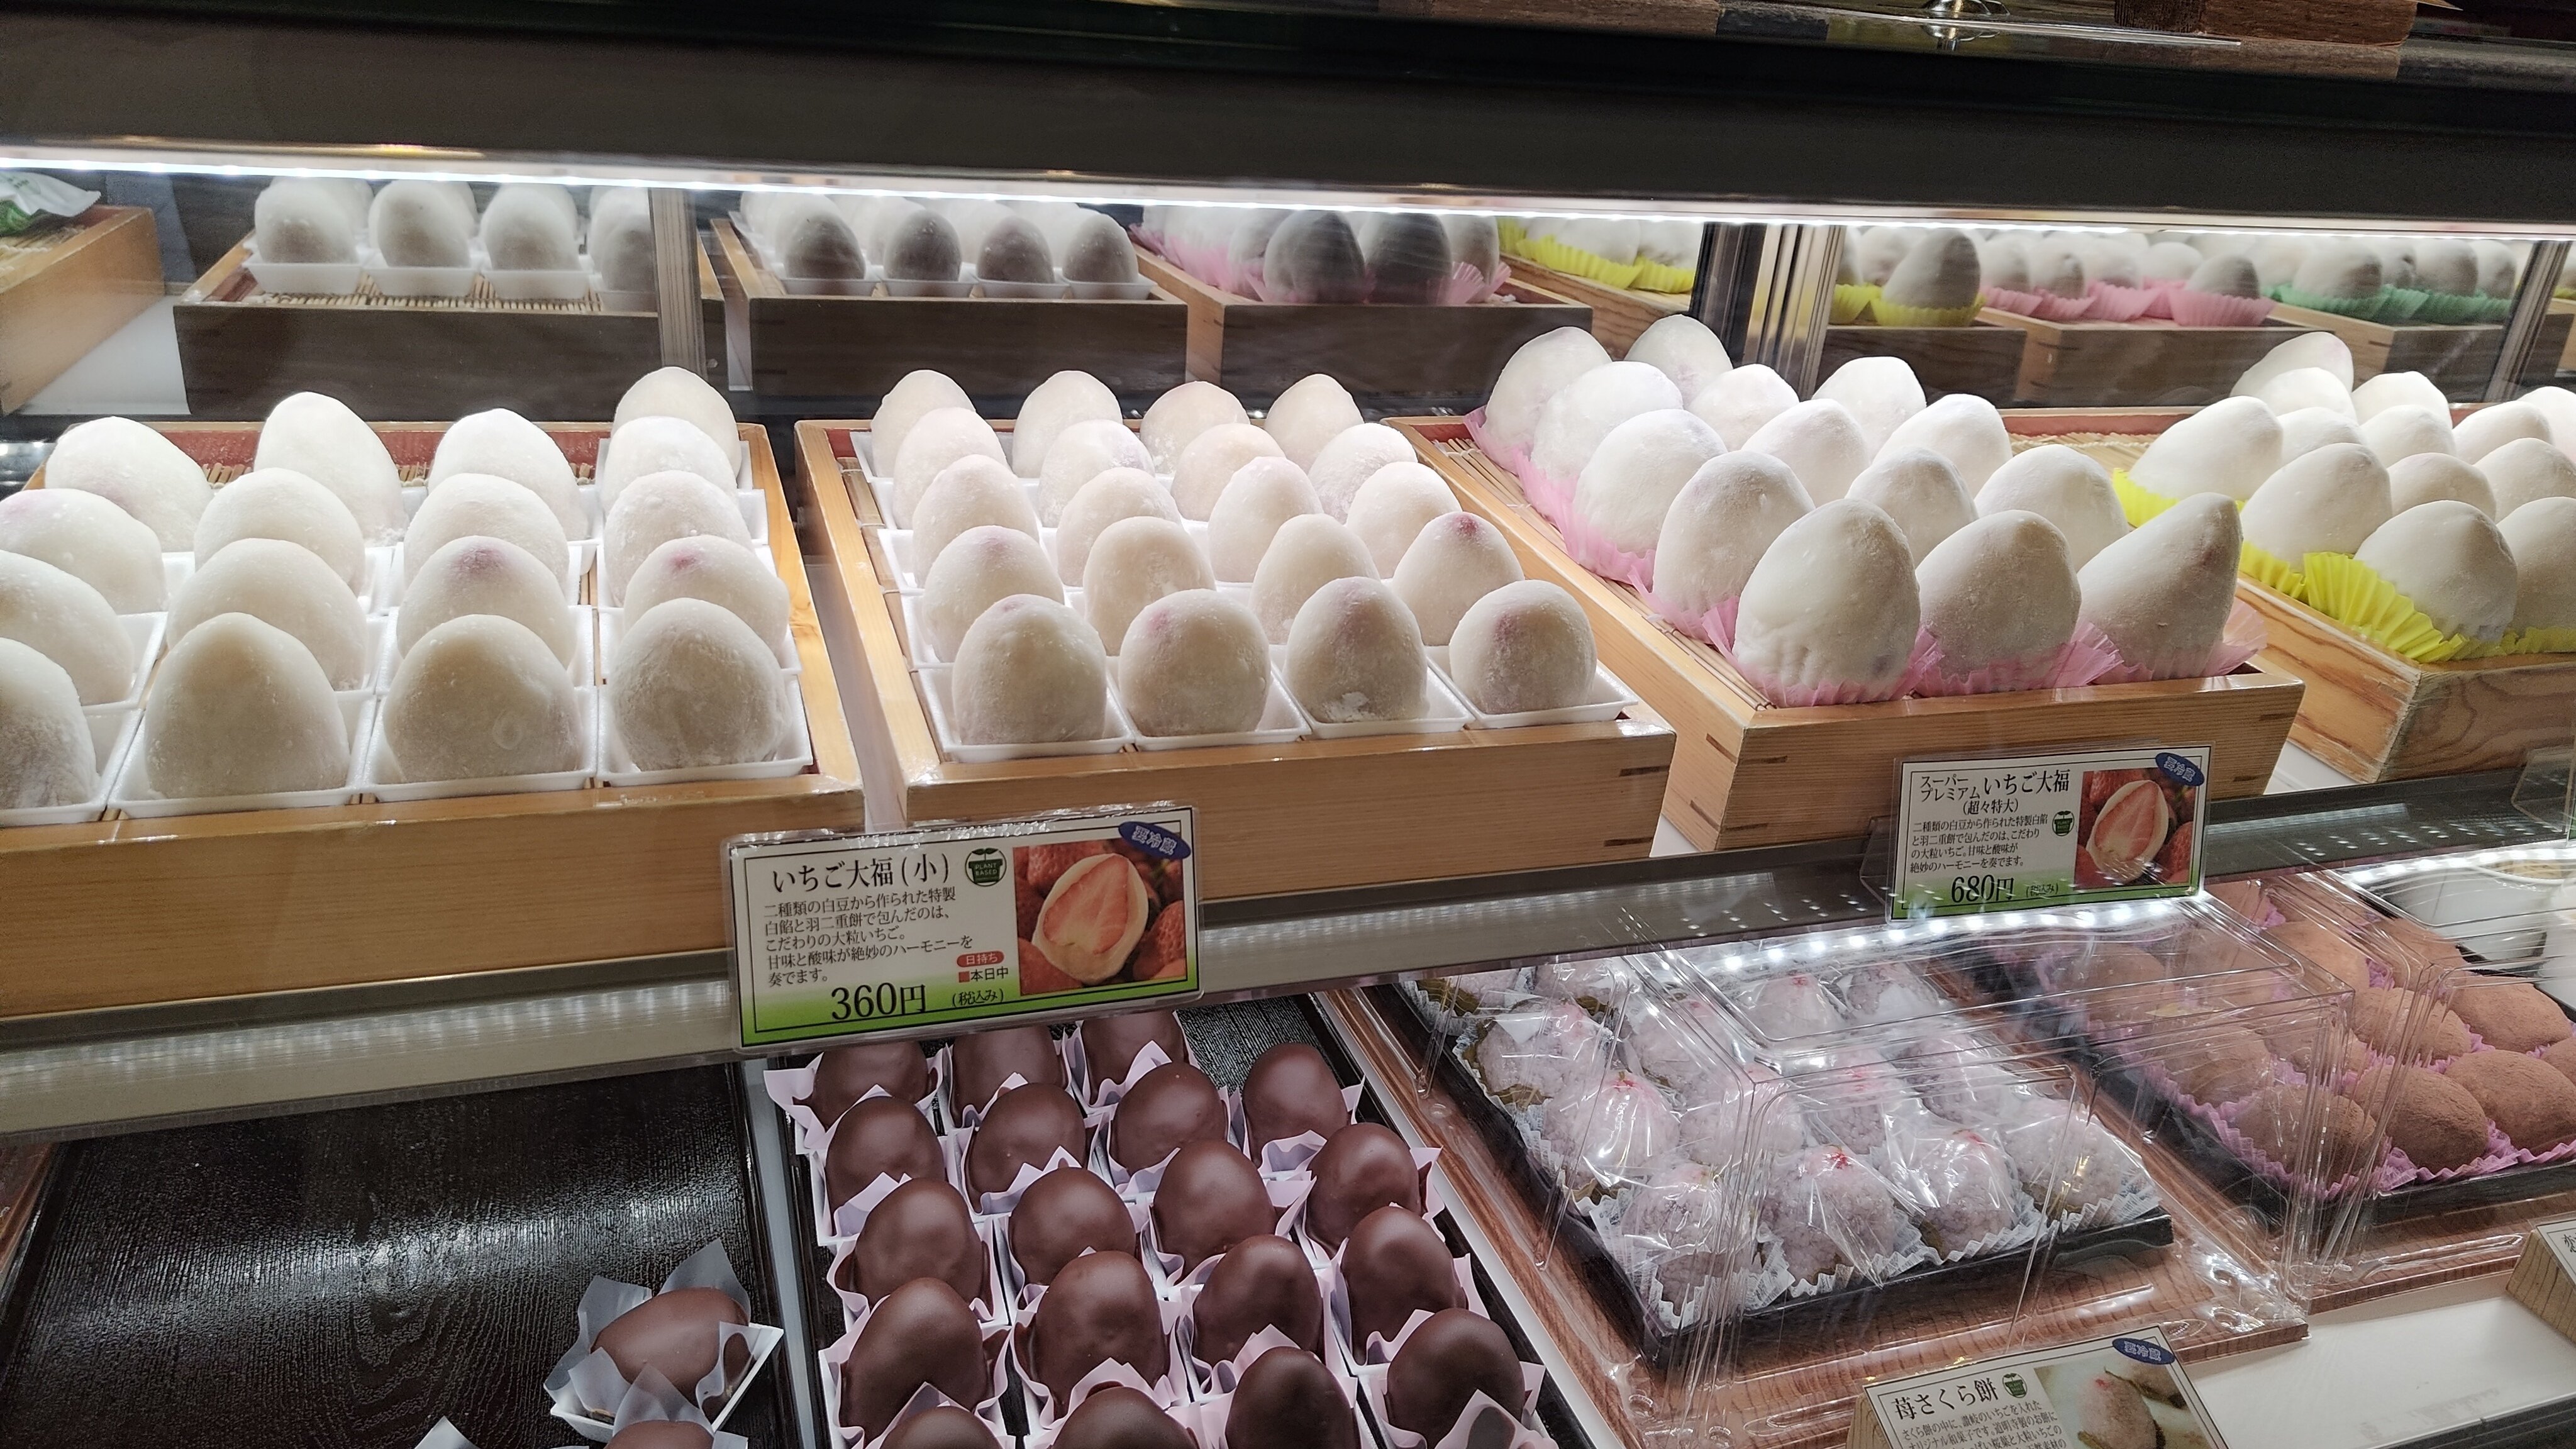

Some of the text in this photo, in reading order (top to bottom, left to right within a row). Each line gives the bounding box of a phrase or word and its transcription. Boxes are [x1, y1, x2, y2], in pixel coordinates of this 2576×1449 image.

[1920, 774, 1969, 787] スーパー
[1984, 769, 2070, 795] いちご大福
[2163, 756, 2196, 782] 要冷蔵
[1921, 787, 1980, 802] プレミアム
[1963, 798, 2019, 816] (超々特大)
[1131, 825, 1177, 855] 要冷蔵
[1910, 855, 2024, 874] 絶妙のハーモニーを奏でます。
[1951, 874, 2014, 903] 680円
[764, 886, 956, 918] 二種類の白豆から作られた特製
[765, 906, 950, 936] 白餡と羽二重餅で包んだのは、
[766, 926, 906, 952] こだわりの大粒いちご。
[768, 935, 973, 970] 甘味と酸味が絶妙のハーモニーを
[966, 952, 998, 965] 日持ち
[769, 969, 828, 987] 奏でます。
[970, 966, 1009, 982] 本日中
[831, 982, 926, 1020] 360円
[952, 988, 1004, 1008] (税込み)
[2124, 1340, 2162, 1362] 要冷蔵
[1891, 1377, 1999, 1420] 苺さくら餅
